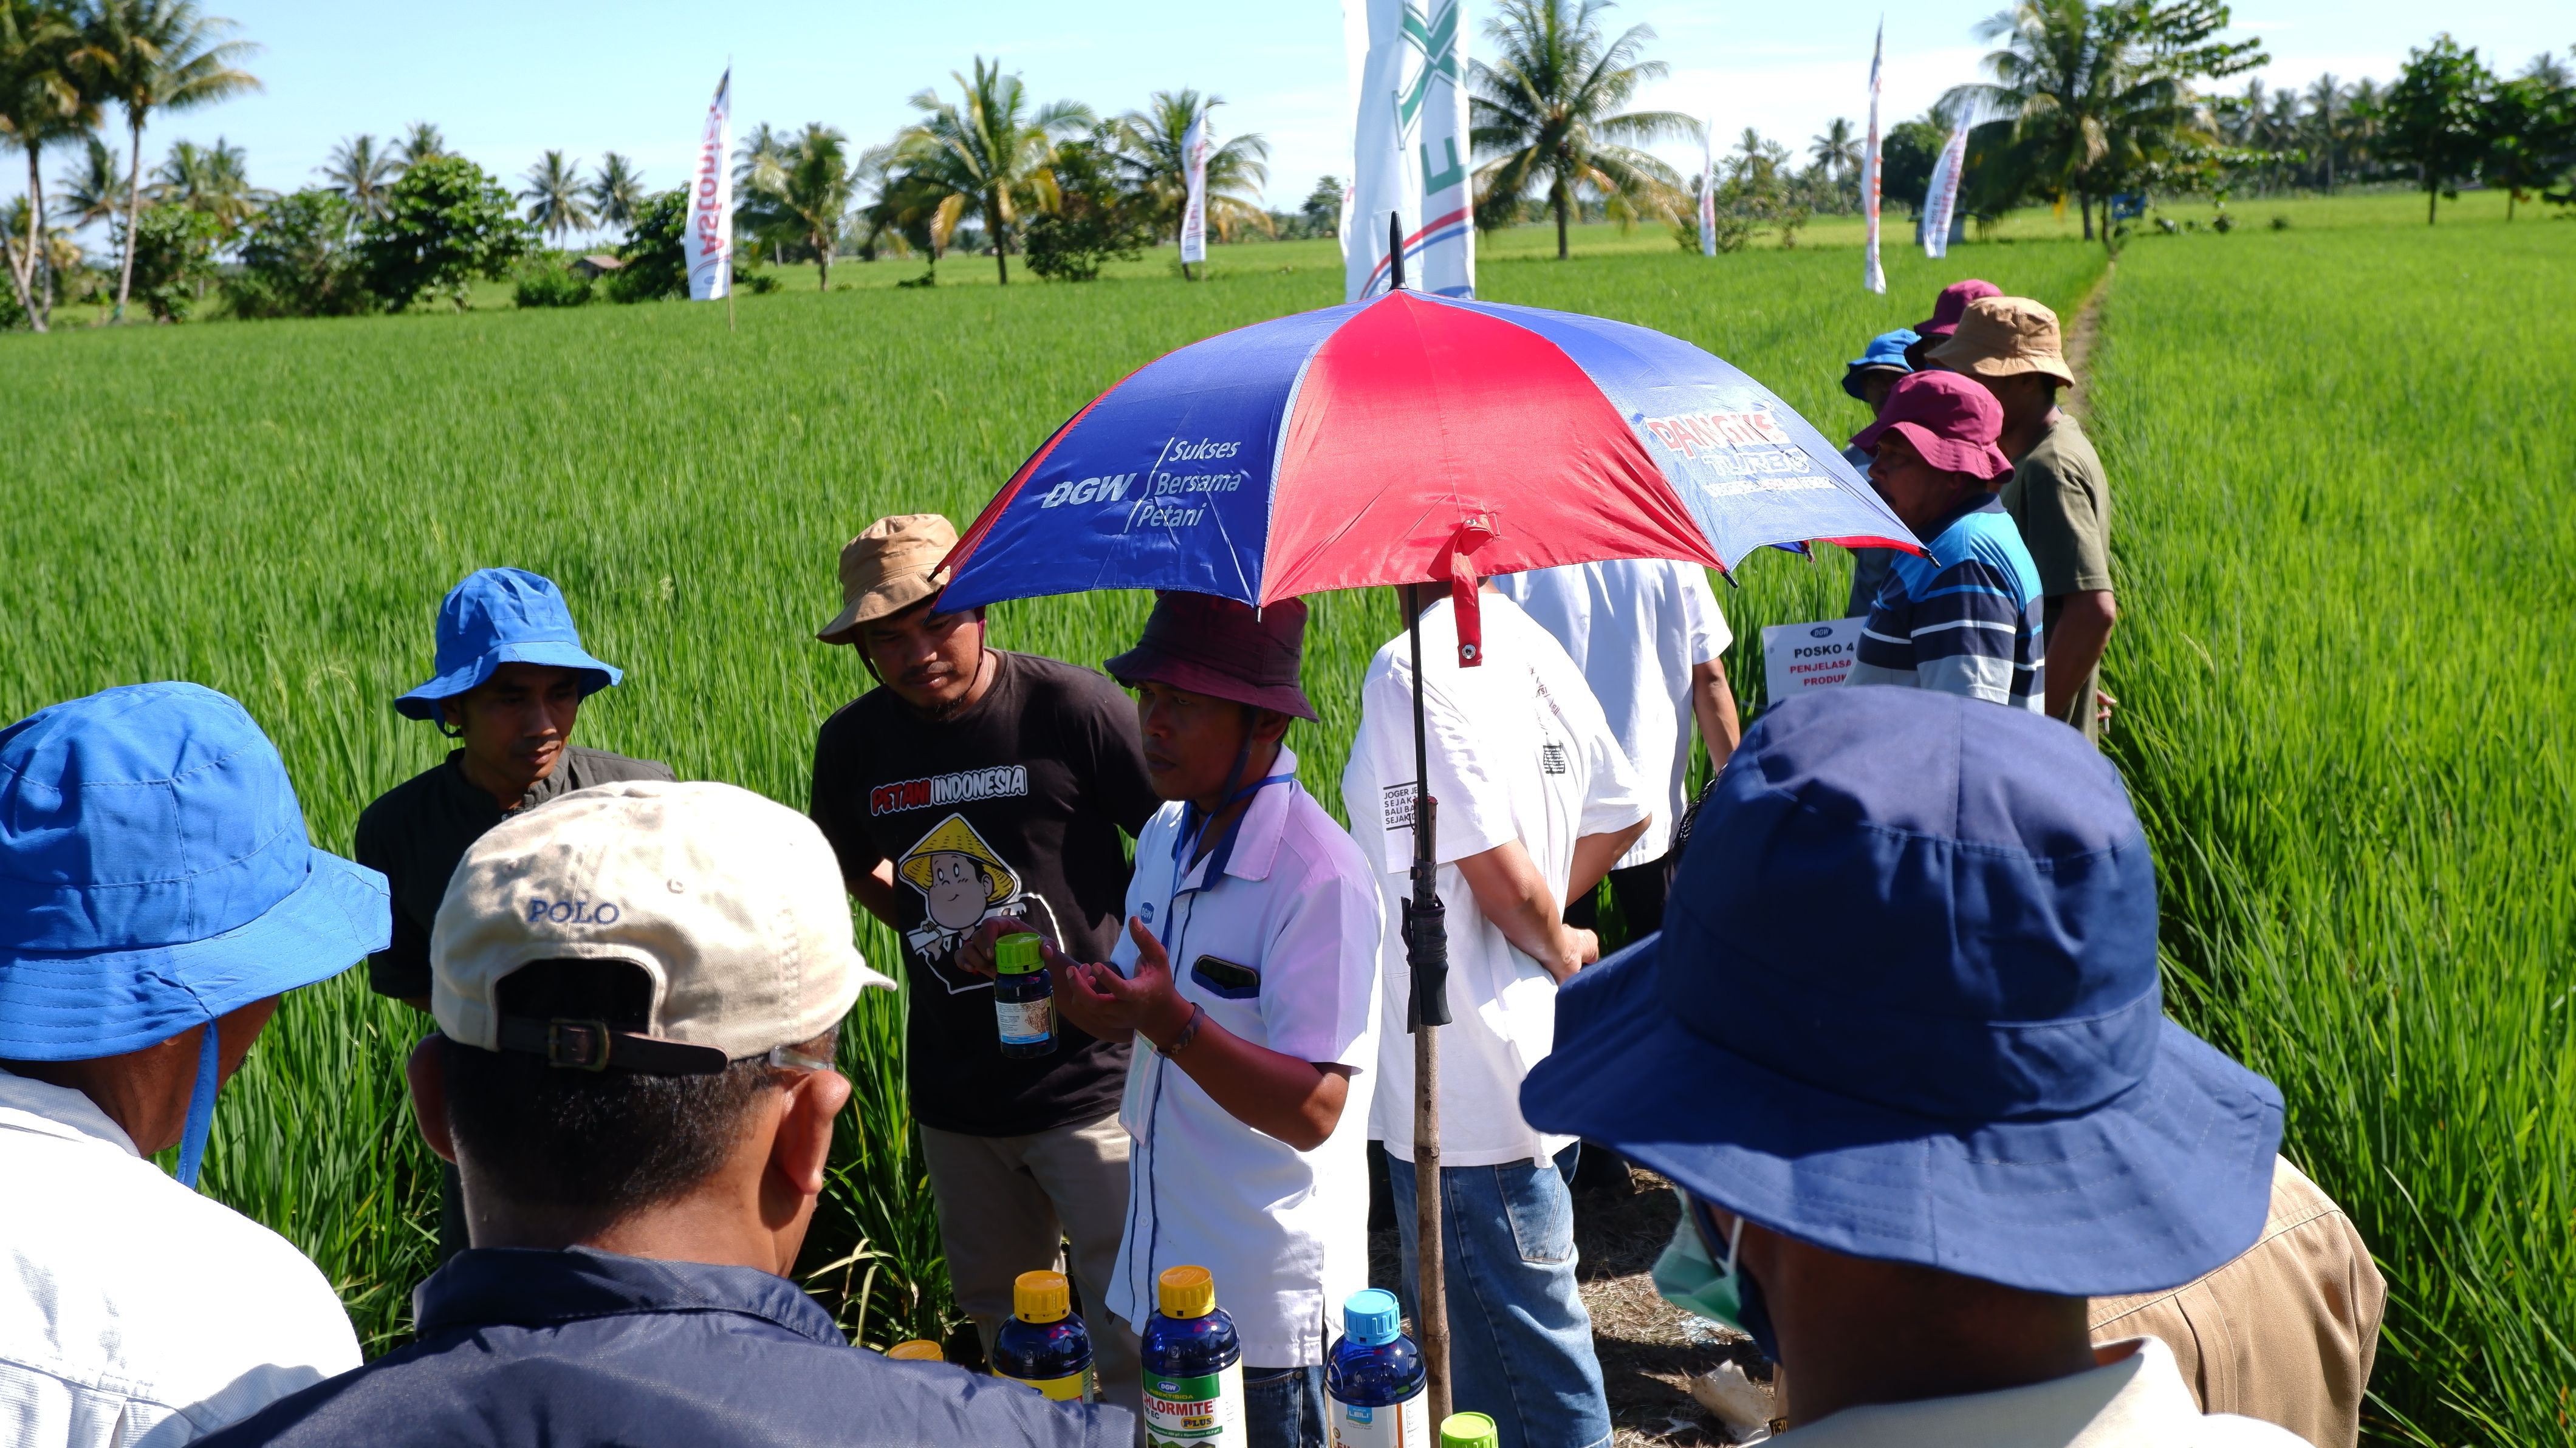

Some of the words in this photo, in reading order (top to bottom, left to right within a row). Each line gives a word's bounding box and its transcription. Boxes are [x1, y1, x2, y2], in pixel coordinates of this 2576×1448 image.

[1169, 437, 1242, 462] Sukses
[1154, 471, 1242, 496] Bersama
[1040, 472, 1138, 510] DGW
[1136, 502, 1208, 528] Petani
[1814, 628, 1829, 637] DGW
[1794, 644, 1842, 659] POSKO
[1846, 641, 1855, 653] 4
[1789, 659, 1852, 674] PENJELASA
[871, 778, 932, 816] PETANI
[933, 765, 1027, 805] INDONESIA
[1383, 788, 1410, 799] JOGER
[1384, 796, 1413, 808] SEJAK
[1385, 807, 1402, 816] BALI
[1404, 804, 1415, 813] BA
[1385, 814, 1410, 824] SEJAK
[528, 898, 620, 924] POLO
[1160, 1383, 1176, 1392] DGW
[1151, 1410, 1160, 1420] EC
[1183, 1417, 1212, 1427] PLUS
